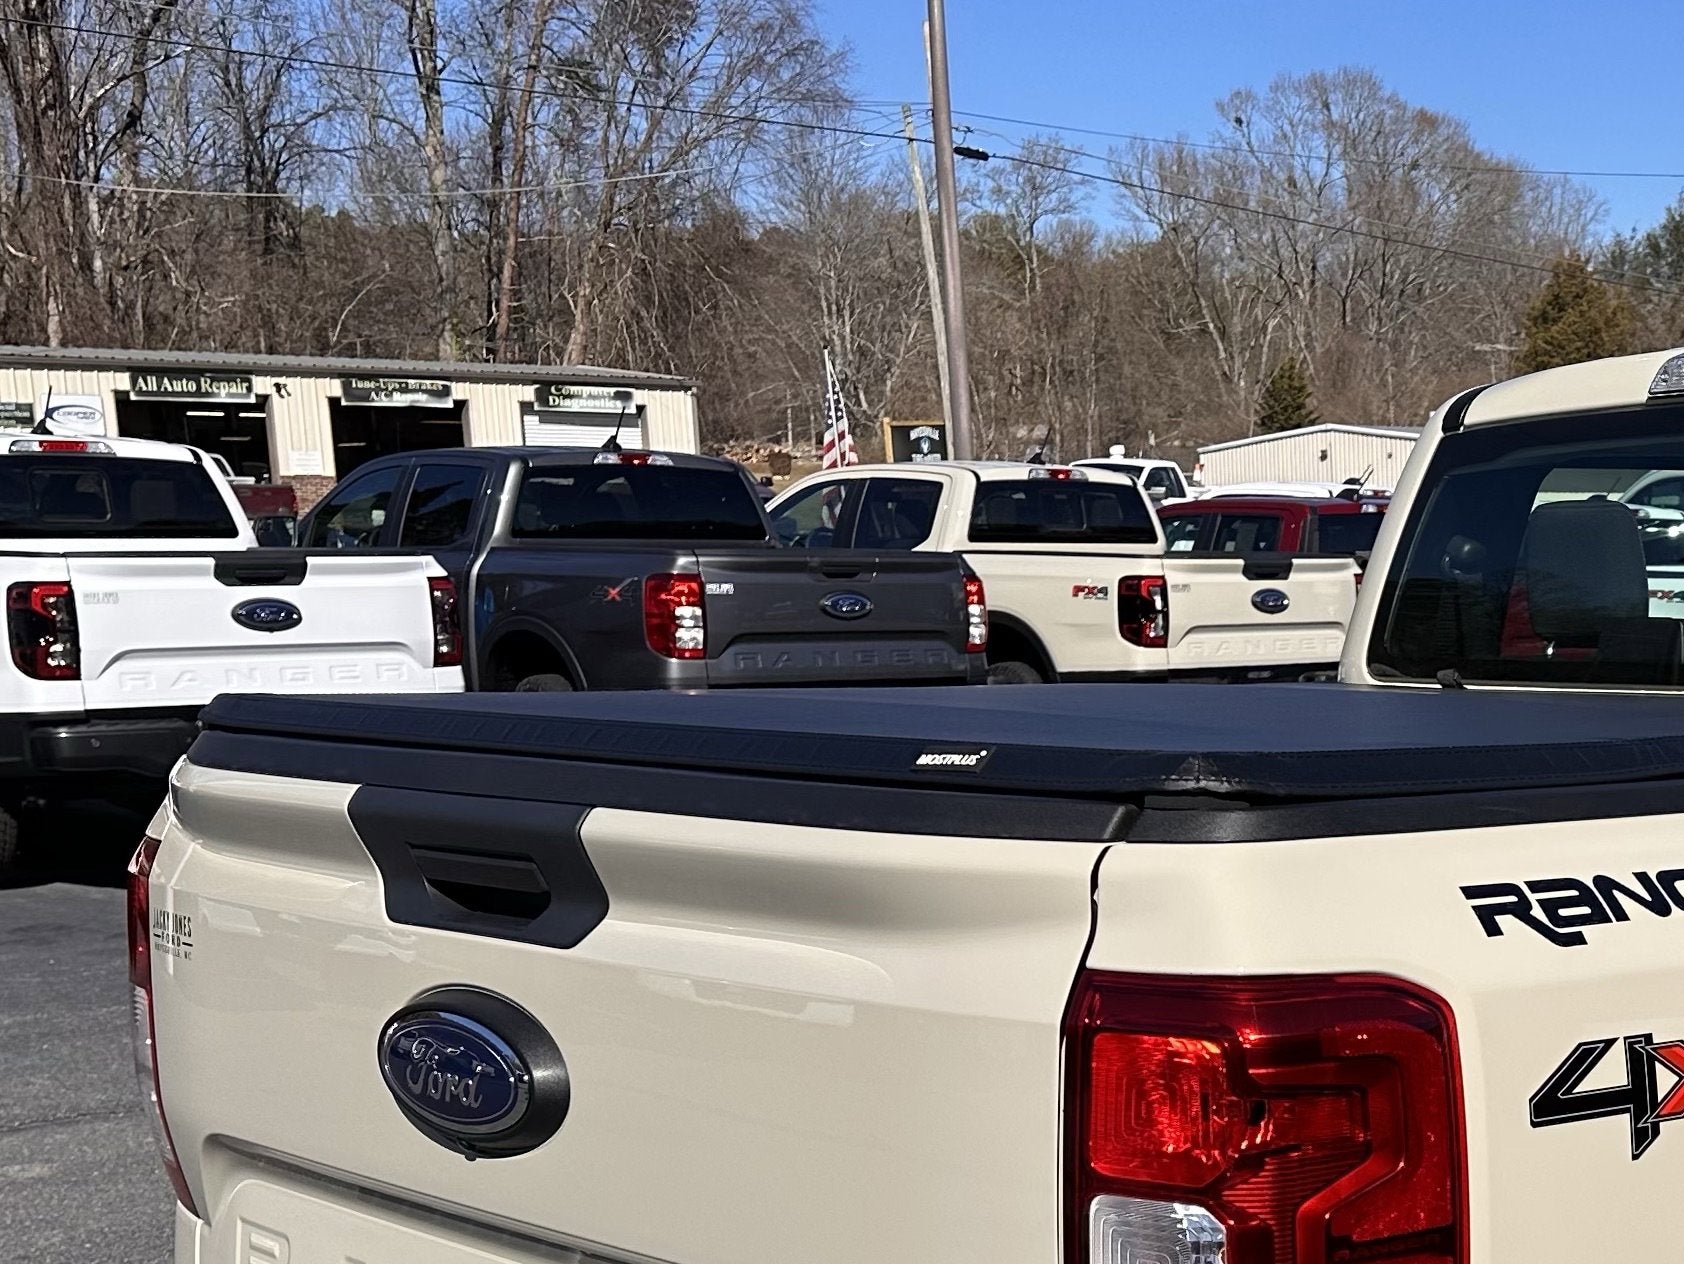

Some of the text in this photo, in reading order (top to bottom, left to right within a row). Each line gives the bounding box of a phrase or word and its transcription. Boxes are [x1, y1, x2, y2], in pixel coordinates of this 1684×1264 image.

[135, 376, 249, 398] All Auto Repair
[733, 649, 951, 670] RANGER
[1186, 637, 1341, 658] RANGER
[119, 662, 408, 691] RANGER
[172, 912, 192, 938] JONES
[406, 1036, 484, 1109] Ford
